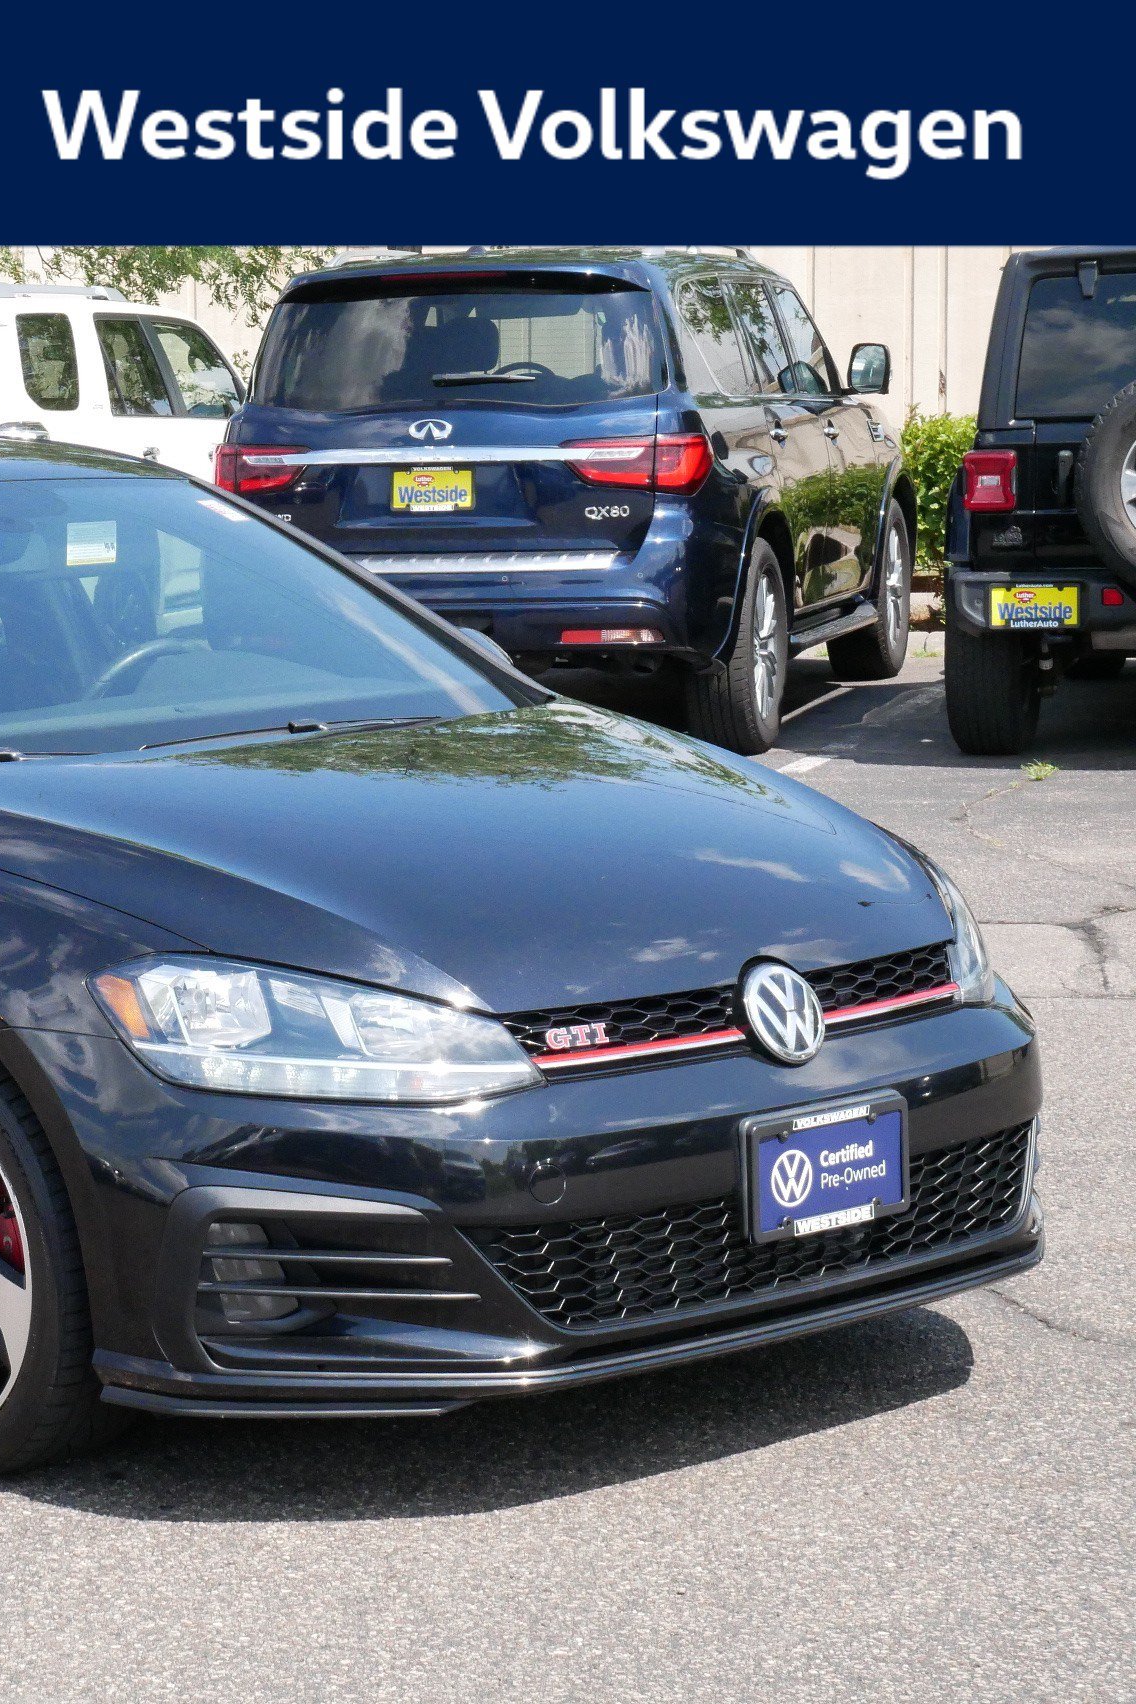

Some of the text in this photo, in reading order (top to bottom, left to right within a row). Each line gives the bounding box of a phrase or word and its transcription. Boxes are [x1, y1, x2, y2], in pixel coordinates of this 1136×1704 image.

[397, 485, 468, 504] Westside
[584, 505, 630, 520] QX80
[997, 602, 1073, 620] Westside
[1010, 619, 1059, 628] LutherAuto
[545, 1022, 610, 1050] GTI
[795, 1106, 870, 1128] VOLKSWAGEN
[820, 1140, 874, 1167] Certified
[820, 1160, 887, 1189] Pre-Owned
[796, 1206, 873, 1235] WESTSIDE
